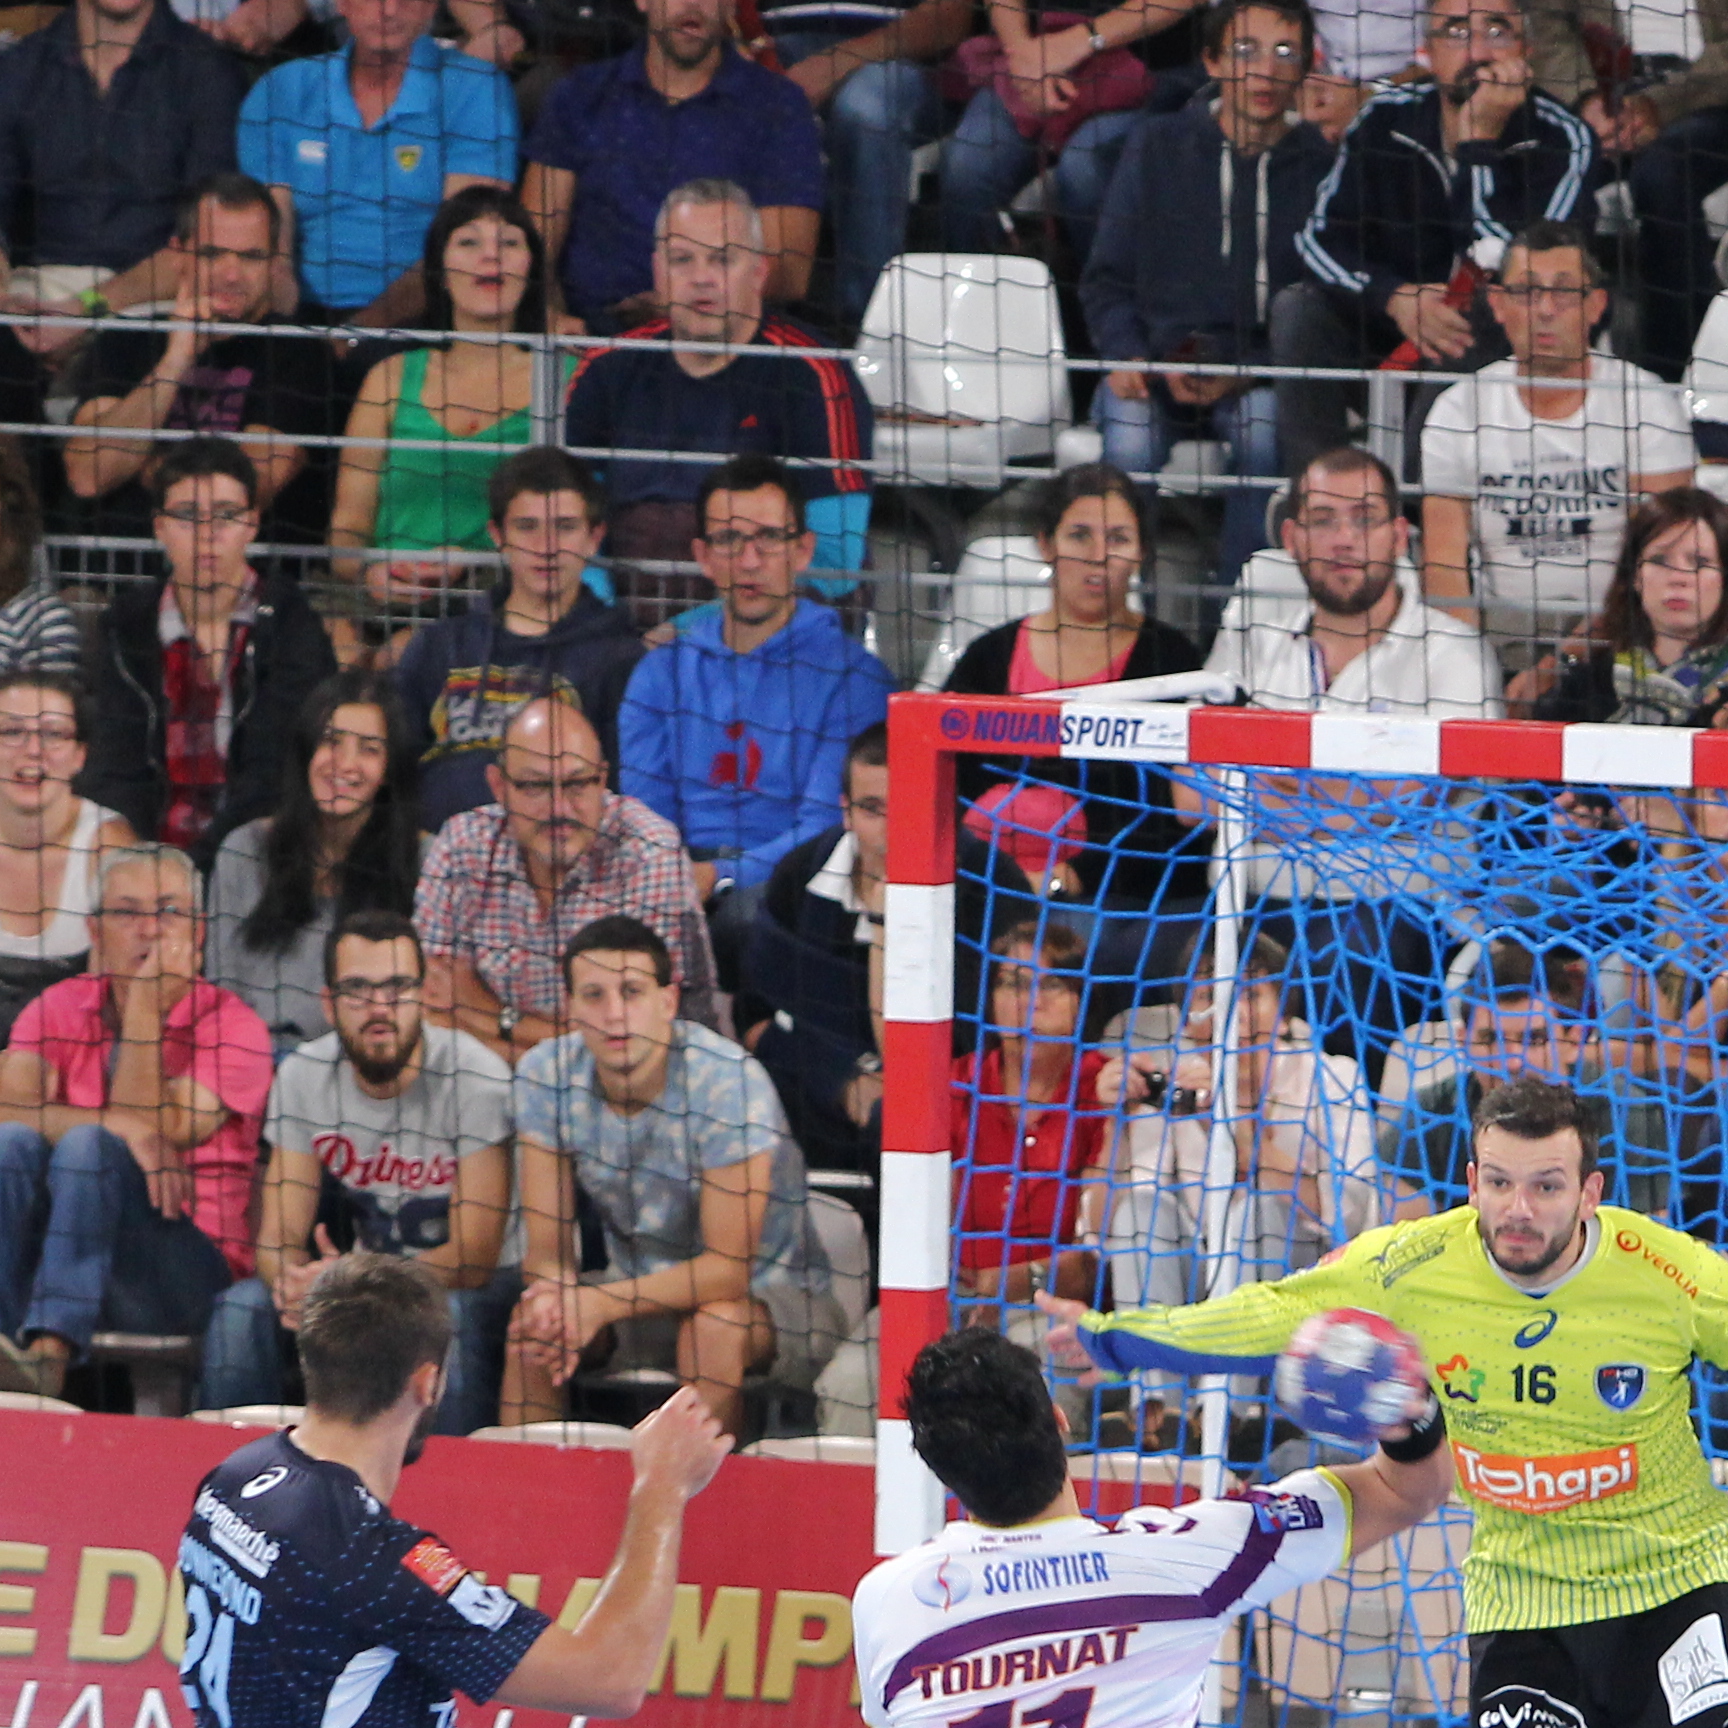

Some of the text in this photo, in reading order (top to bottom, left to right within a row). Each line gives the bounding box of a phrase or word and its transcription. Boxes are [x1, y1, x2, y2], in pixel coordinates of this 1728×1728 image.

[974, 710, 1144, 747] NOUANSPORT
[1511, 1363, 1557, 1405] 16
[911, 1624, 1141, 1700] TOURNAT
